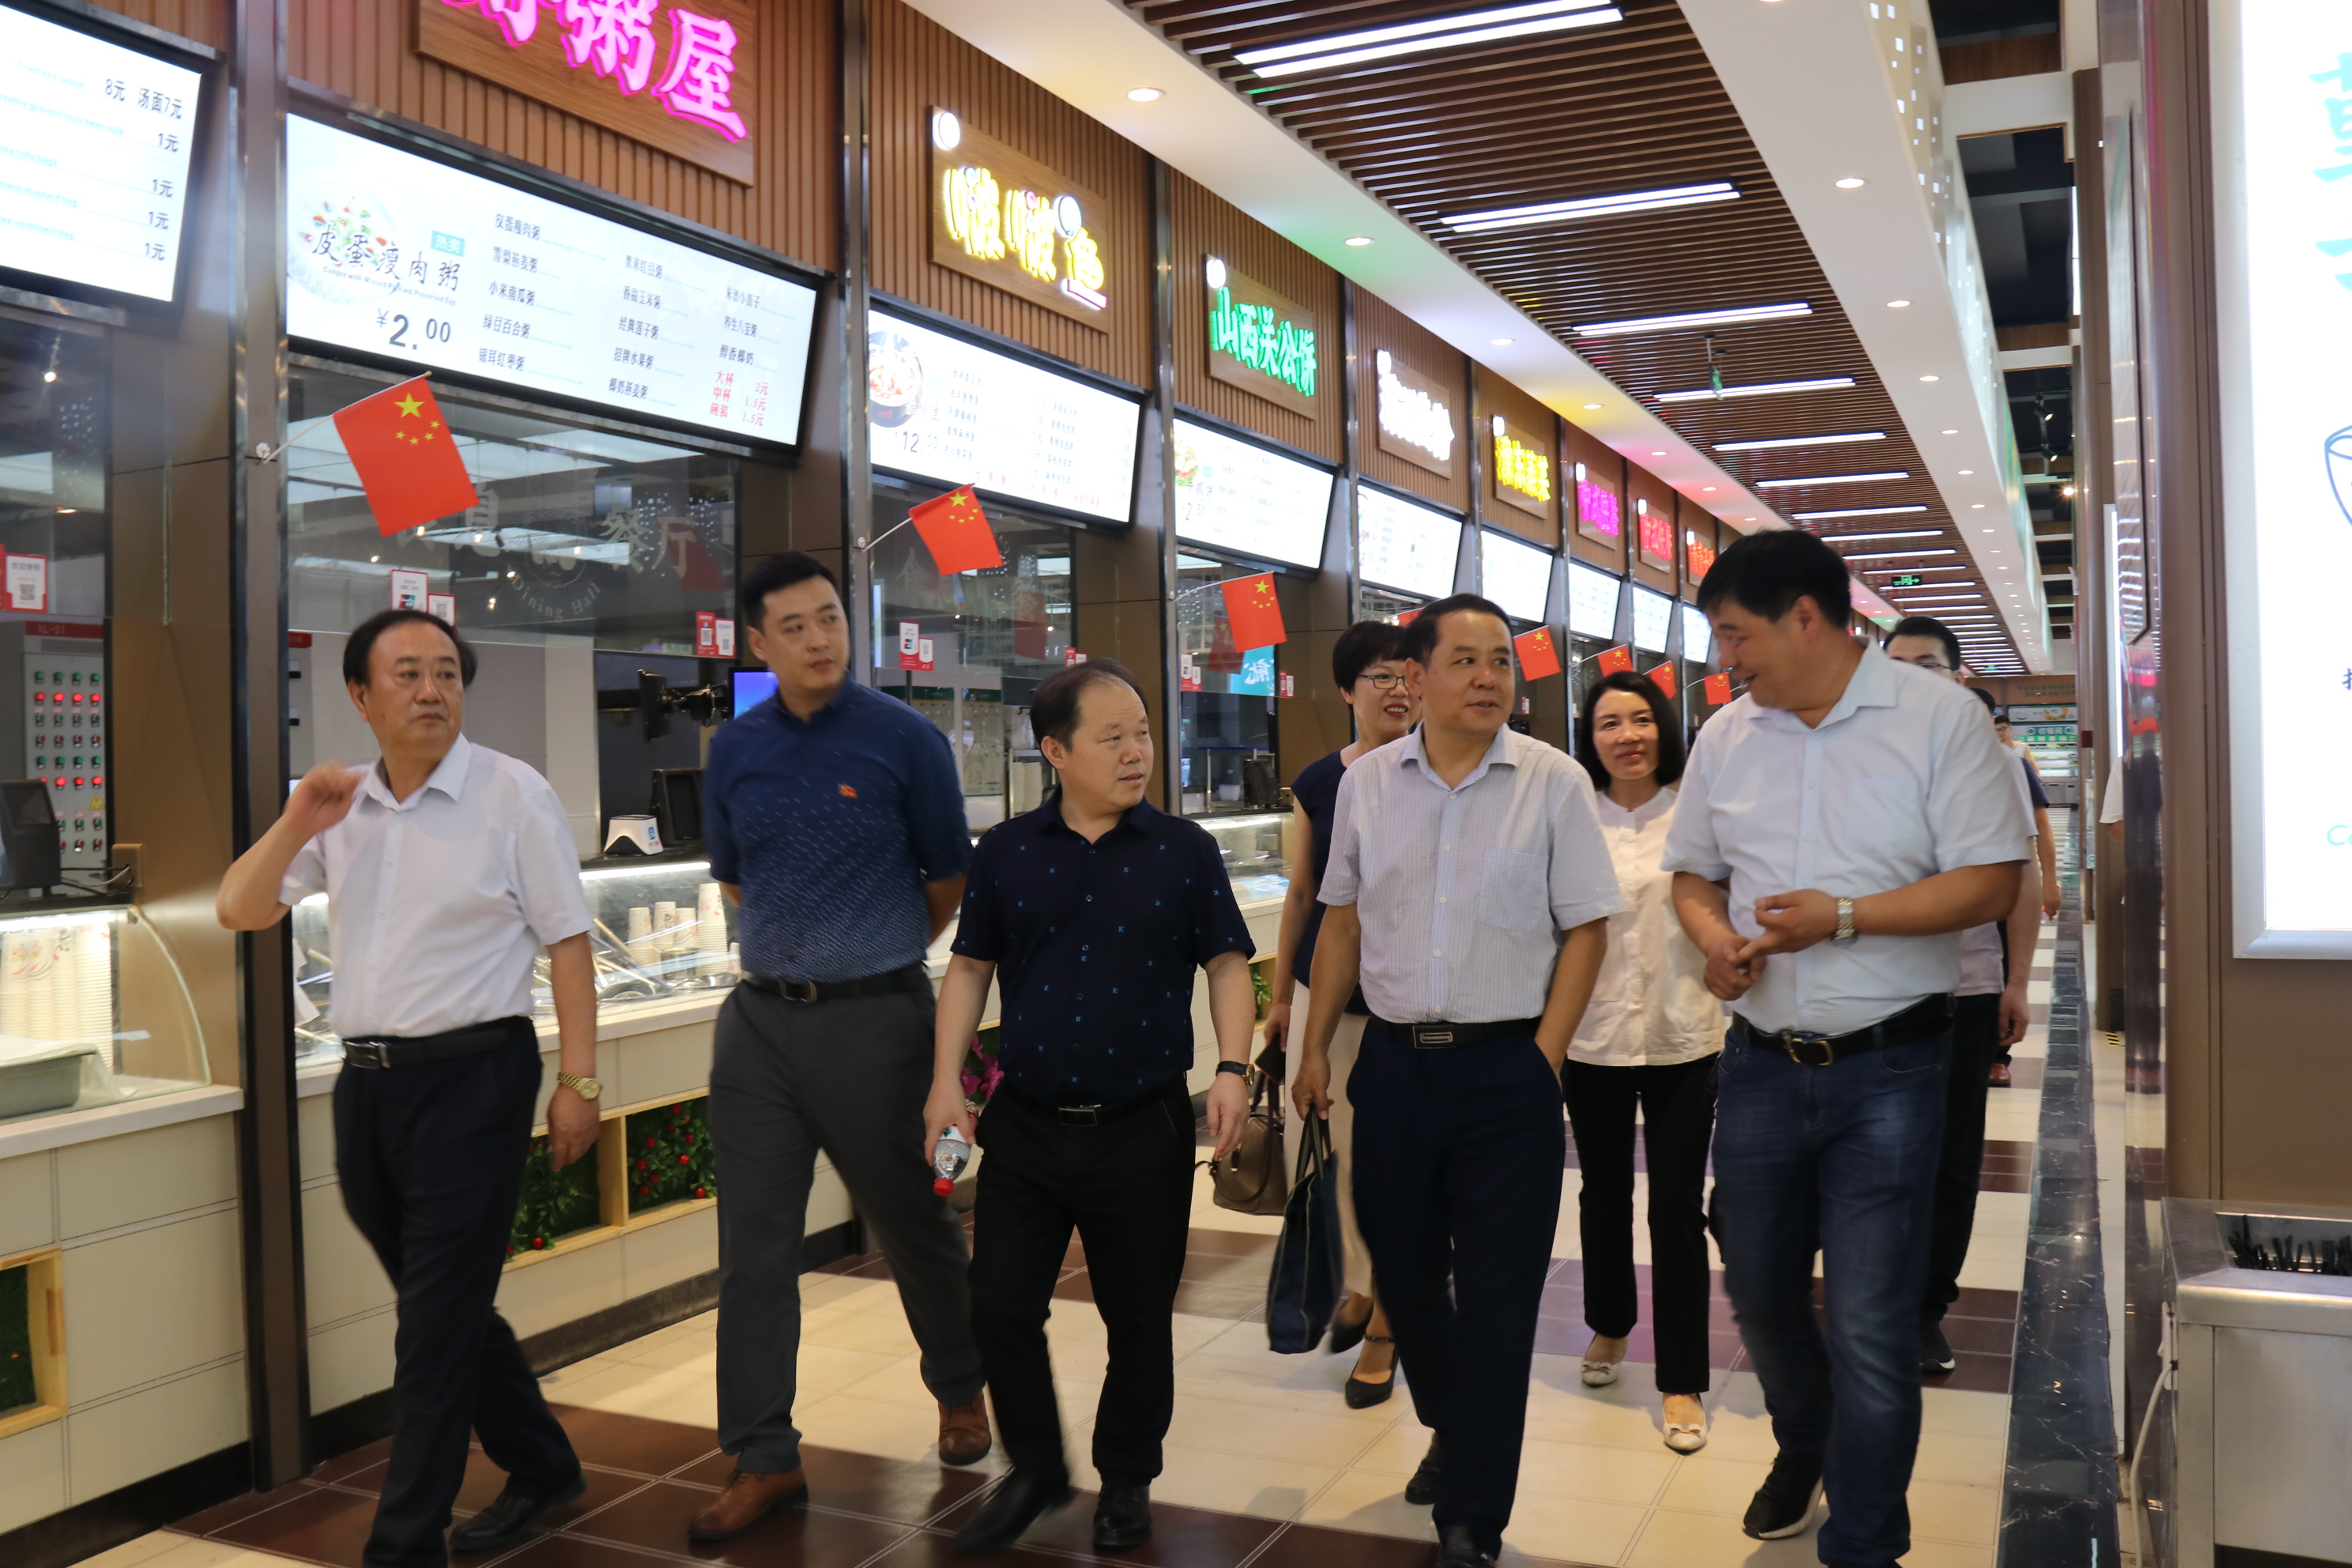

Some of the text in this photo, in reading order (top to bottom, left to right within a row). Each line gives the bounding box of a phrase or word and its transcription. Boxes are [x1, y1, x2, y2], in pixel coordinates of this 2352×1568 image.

[104, 78, 183, 119] 8元 汤面7元
[158, 133, 179, 152] 1元
[152, 179, 173, 198] 1元
[148, 211, 169, 229] 1元
[144, 243, 165, 262] 1元
[312, 223, 460, 292] 皮蛋瘦肉粥
[488, 281, 535, 306] 小米南瓜粥
[482, 314, 531, 339] 绿豆百合粥
[618, 316, 659, 340] 经典莲子粥
[724, 316, 757, 337] 养生八宝粥
[478, 347, 526, 371] 银耳红枣粥
[613, 347, 654, 370] 招牌水果粥
[715, 370, 769, 395] 大杯 2元
[713, 386, 767, 411] 中杯 1.5元
[710, 402, 764, 427] 碗装 1.5元
